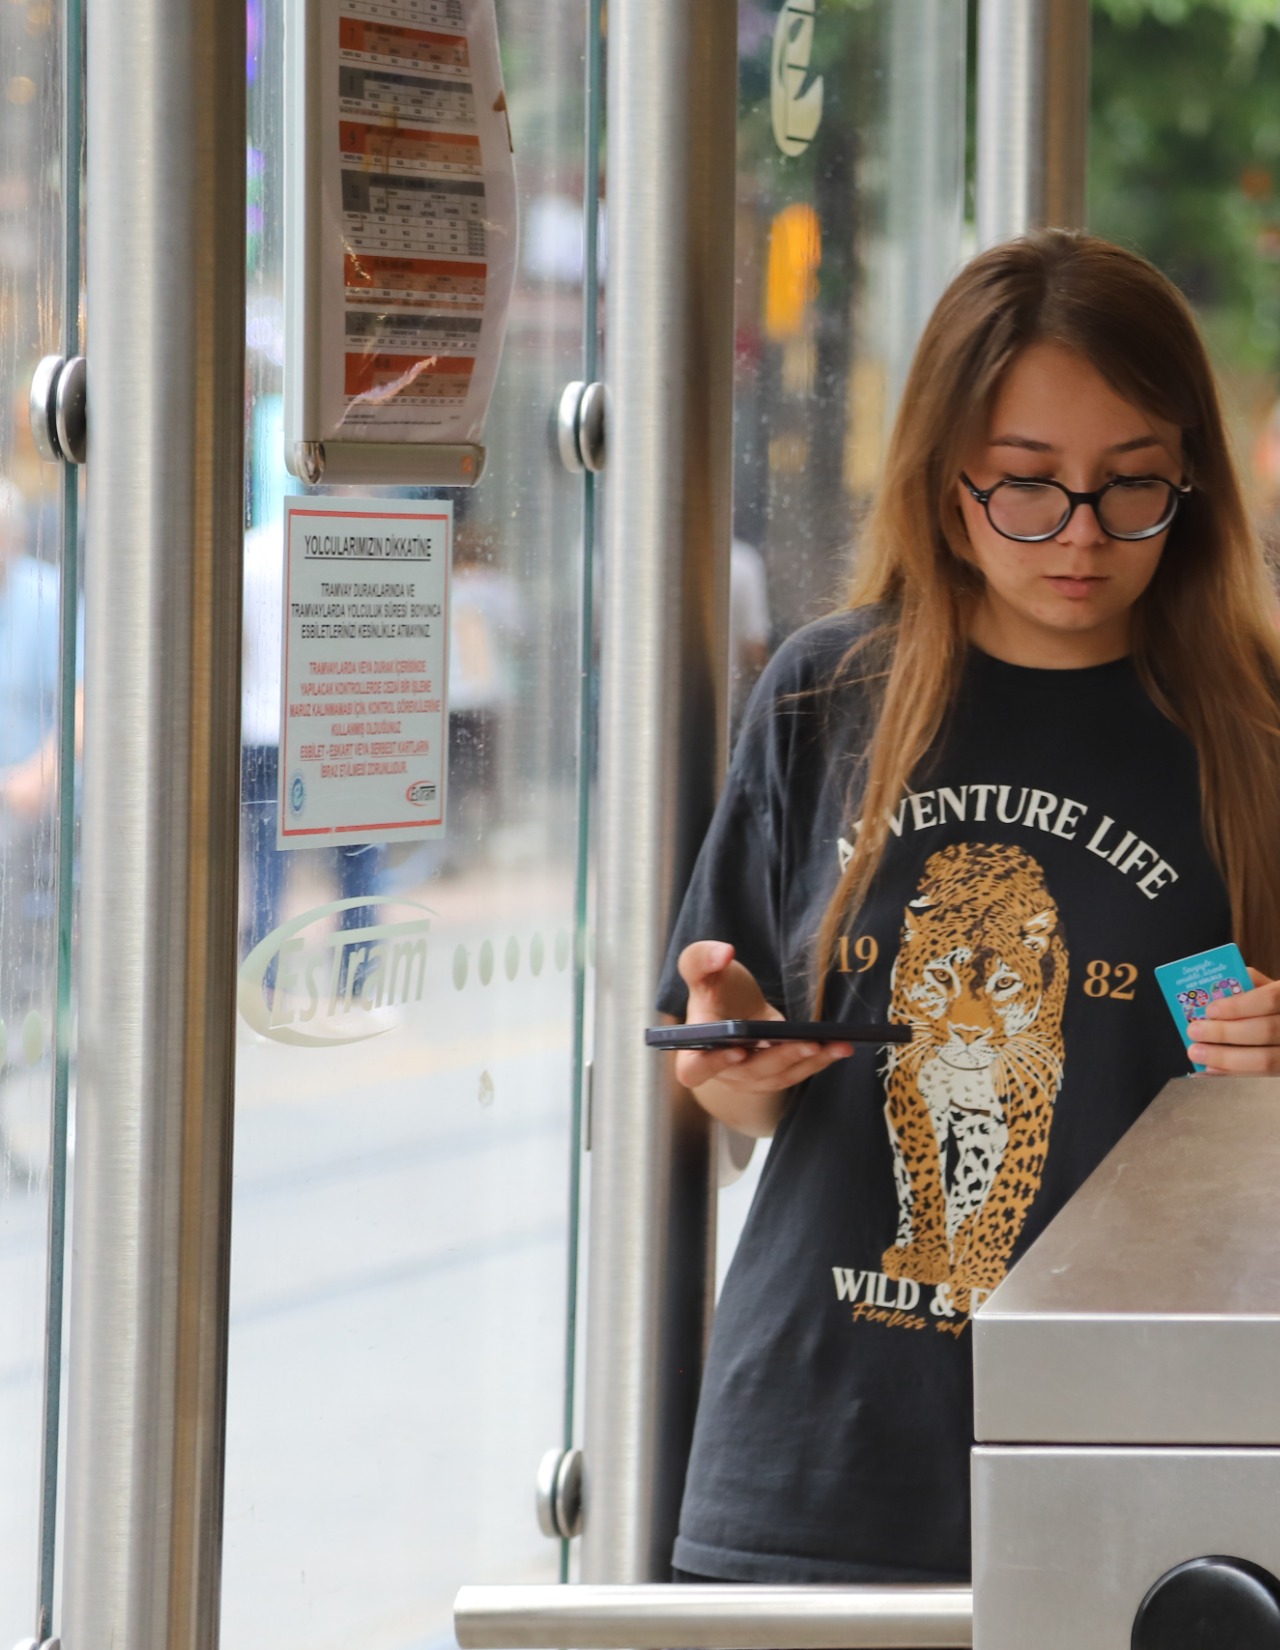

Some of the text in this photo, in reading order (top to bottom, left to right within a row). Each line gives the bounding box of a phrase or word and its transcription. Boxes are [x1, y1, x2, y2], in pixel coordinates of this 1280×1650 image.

[304, 533, 432, 557] YOLCULARIMIZIN DİKKATİNE
[321, 583, 415, 597] TRAMVAY DURAKLARINDA VE
[291, 601, 441, 618] TRAMVAYLARDA YOLCULUK SÜRESİ BOYUNCA
[837, 784, 1179, 900] AVENTURE LIFE
[837, 935, 879, 973] 19
[1083, 960, 1139, 1001] 82
[831, 1266, 921, 1311] WILD
[929, 1282, 957, 1318] &
